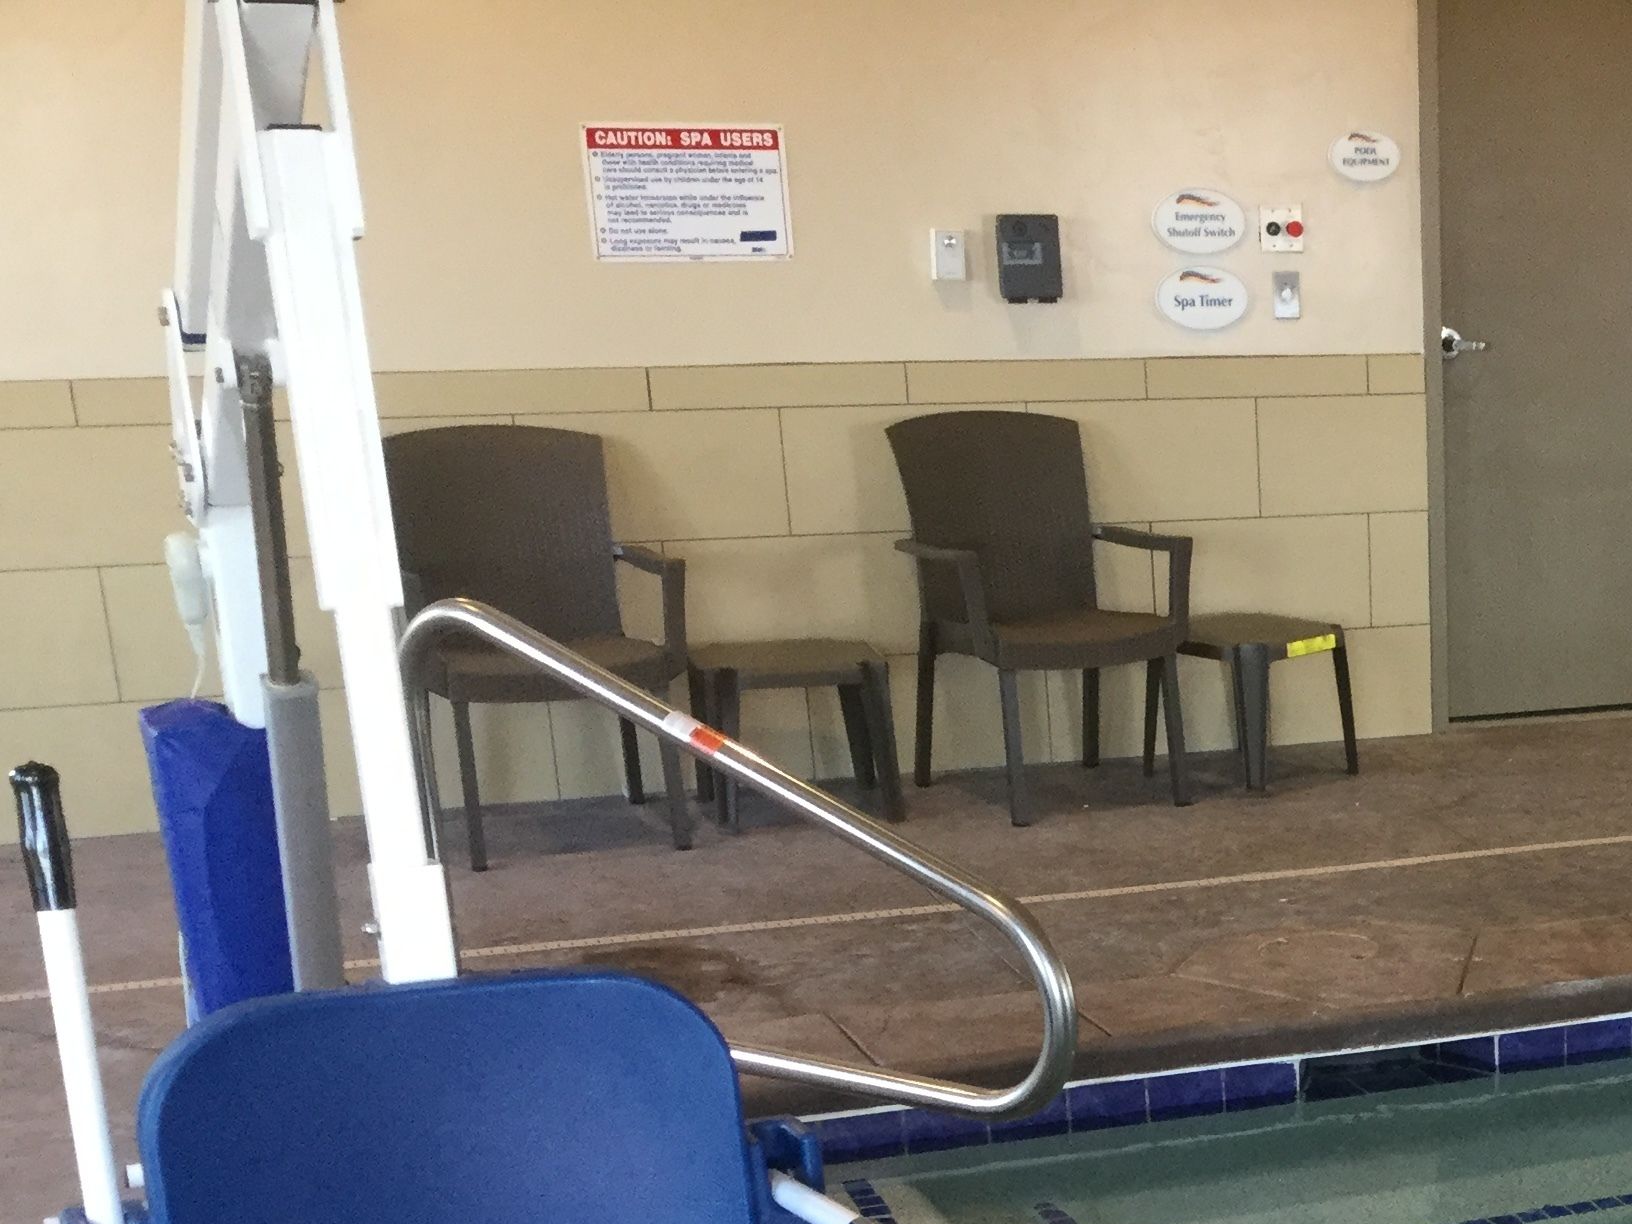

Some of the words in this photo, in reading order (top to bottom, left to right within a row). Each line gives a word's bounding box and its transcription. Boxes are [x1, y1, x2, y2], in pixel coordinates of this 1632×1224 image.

[594, 130, 672, 146] CAUTION:
[680, 131, 712, 147] SPA
[720, 133, 773, 147] USERS
[1175, 211, 1225, 223] Emergency
[1167, 227, 1202, 237] Shutoff
[1203, 227, 1236, 237] Switch
[1174, 294, 1196, 311] Spa
[1199, 294, 1233, 307] Timer
